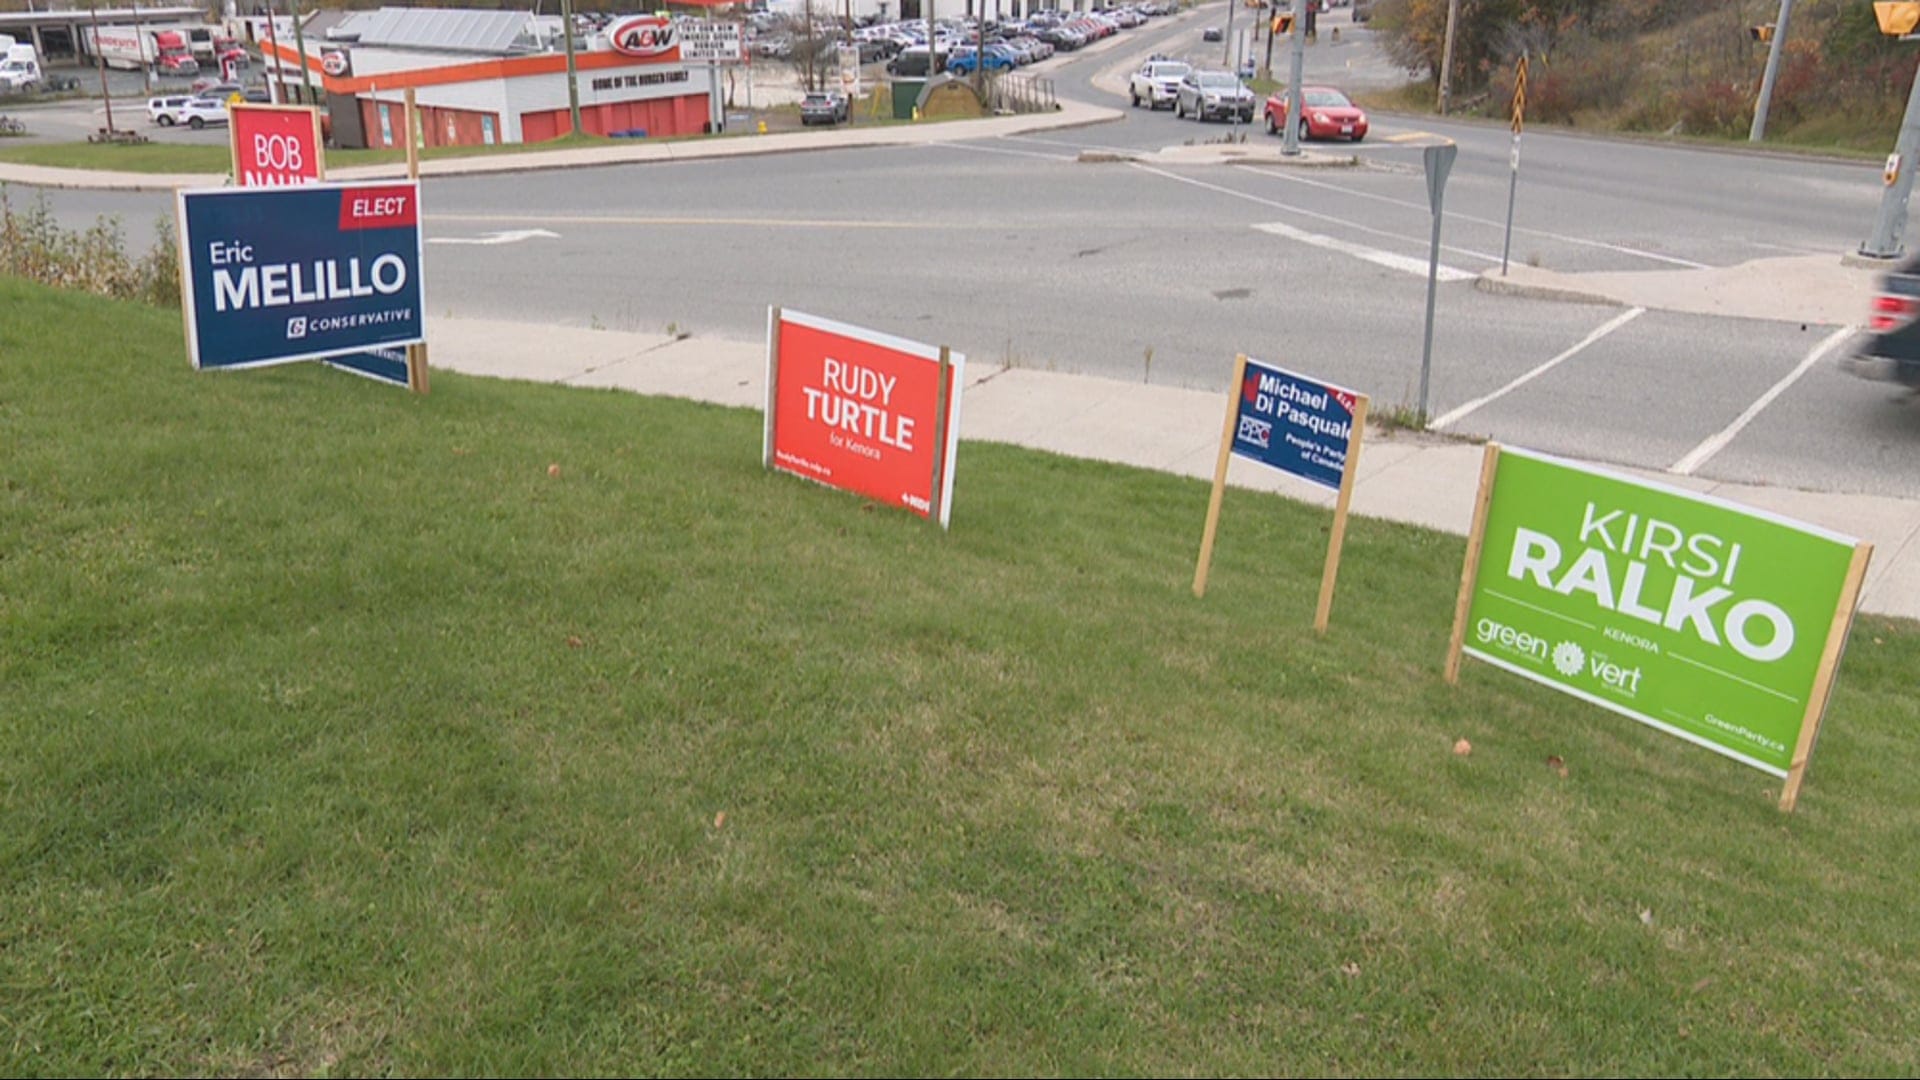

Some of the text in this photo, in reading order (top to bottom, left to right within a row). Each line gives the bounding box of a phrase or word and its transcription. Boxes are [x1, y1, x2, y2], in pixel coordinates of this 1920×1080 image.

[623, 30, 673, 49] A&W
[592, 70, 688, 91] HOME OF THE BURGER FAMILY
[254, 133, 303, 170] BOB
[352, 196, 407, 218] ELECT
[209, 240, 254, 265] Eric
[212, 253, 407, 312] MELILLO
[309, 308, 412, 332] CONSERVATIVE
[823, 357, 897, 407] RUDY
[1258, 373, 1328, 411] Michael
[802, 386, 916, 452] TURTLE
[1255, 394, 1273, 414] Di
[829, 431, 881, 461] for Kenora
[1239, 416, 1271, 447] PPC
[1578, 501, 1742, 585] KIRSI
[1506, 526, 1795, 663] RALKO
[1476, 617, 1548, 659] green
[1591, 656, 1641, 692] vert
[1603, 626, 1659, 654] KENORA
[1704, 713, 1785, 753] GreenParty.ca
